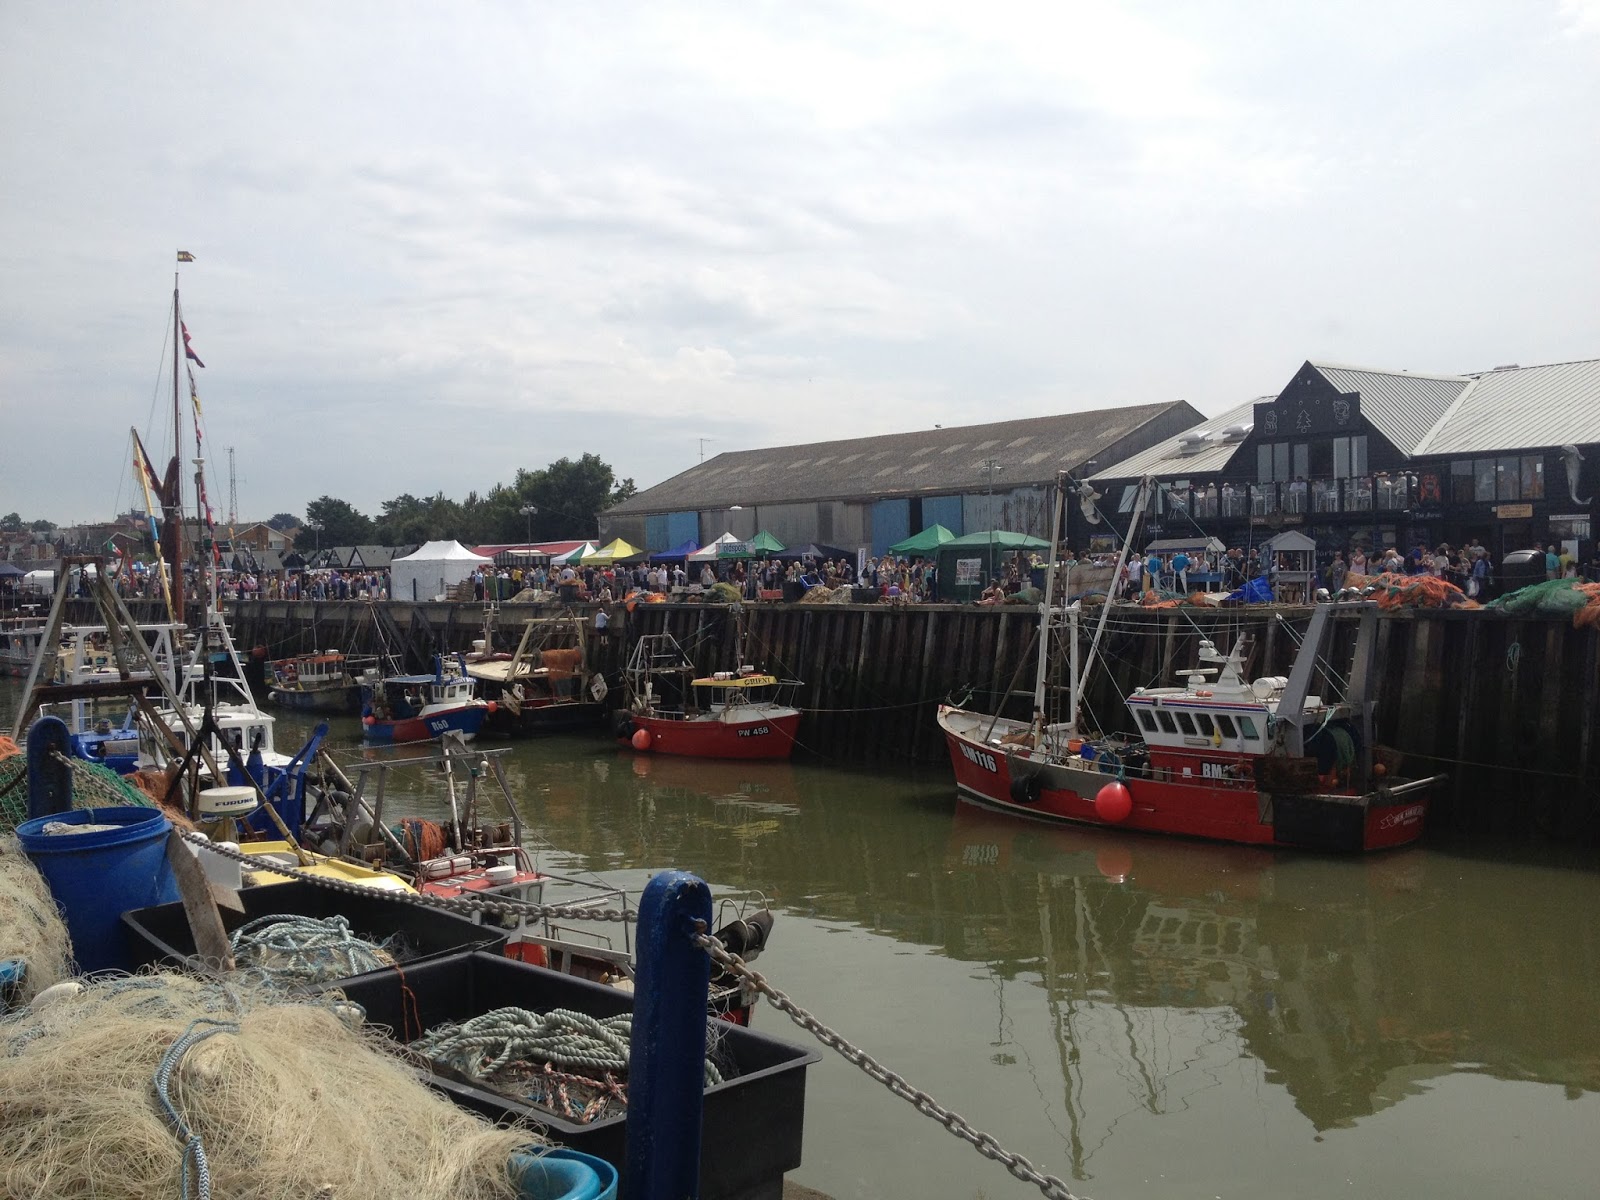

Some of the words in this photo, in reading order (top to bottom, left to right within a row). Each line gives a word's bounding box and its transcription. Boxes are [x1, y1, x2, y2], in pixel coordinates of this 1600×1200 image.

[744, 677, 771, 686] ORIENT
[431, 720, 449, 731] R60
[753, 727, 769, 735] 458
[215, 798, 254, 807] FURUNO
